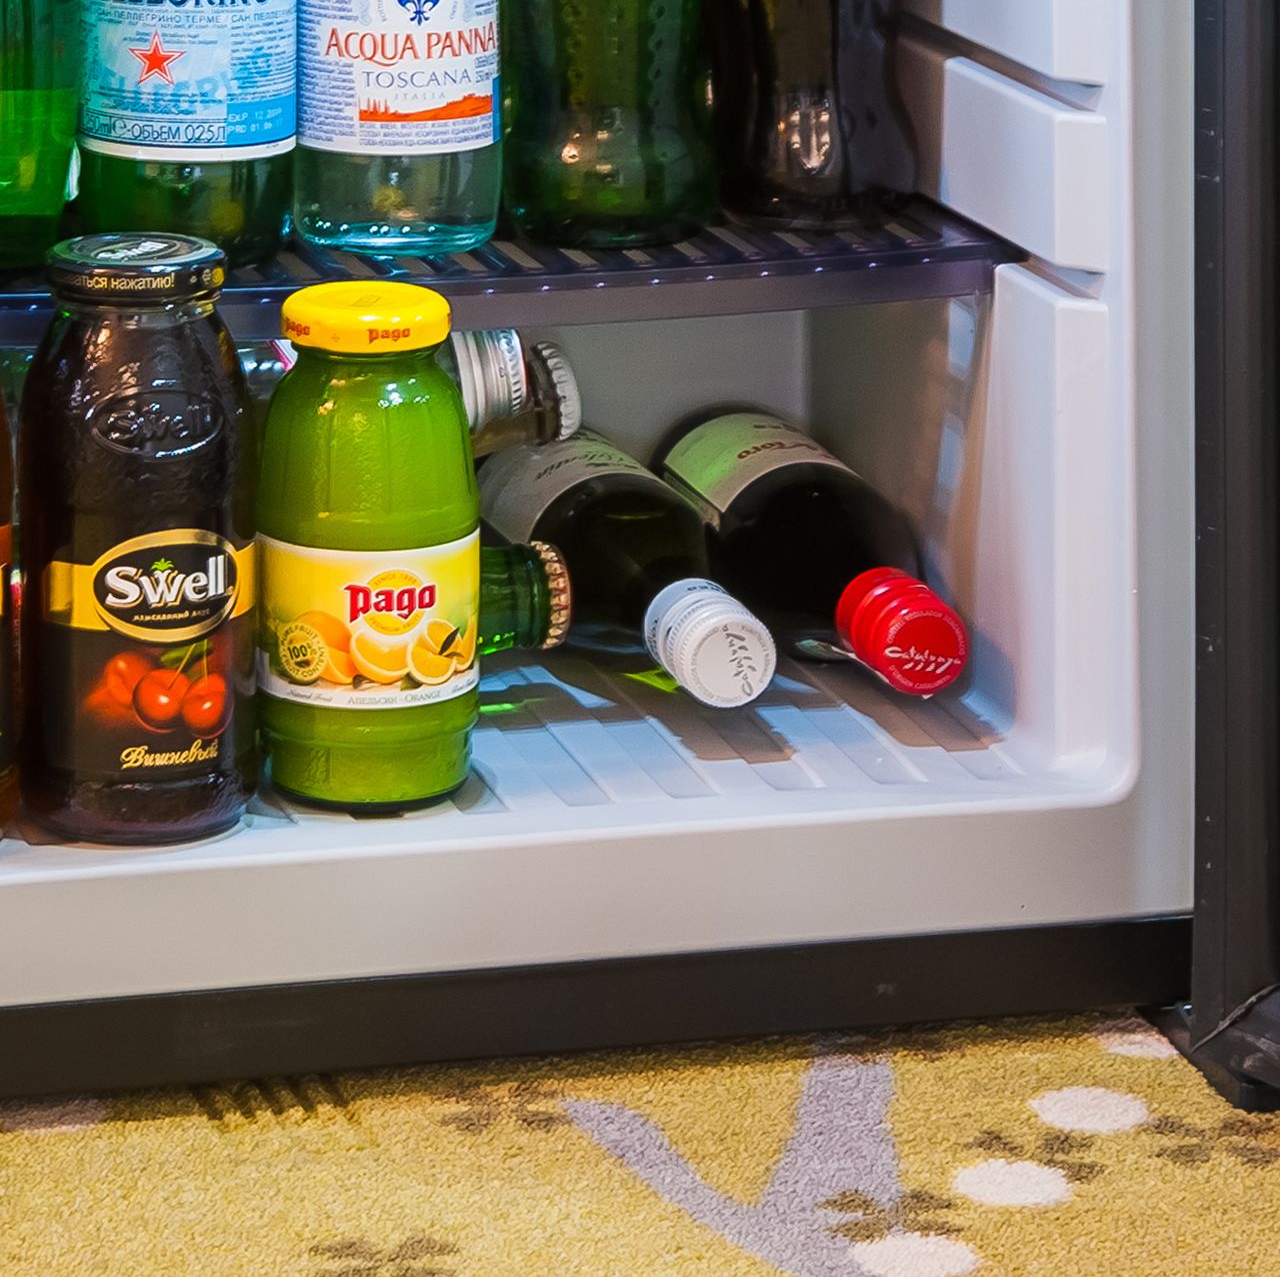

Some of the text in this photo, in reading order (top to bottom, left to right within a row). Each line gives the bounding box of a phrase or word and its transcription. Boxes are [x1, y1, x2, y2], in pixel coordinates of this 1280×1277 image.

[186, 13, 221, 24] ТЕРМЕ
[325, 27, 419, 67] ACQUA
[426, 21, 497, 60] PANNA
[362, 68, 471, 89] TOSCANA
[395, 91, 447, 102] ITALIA
[111, 272, 175, 290] нажатию!
[368, 328, 411, 344] pago
[104, 554, 227, 608] Swell
[343, 584, 436, 624] pago
[120, 739, 220, 770] Вишневый
